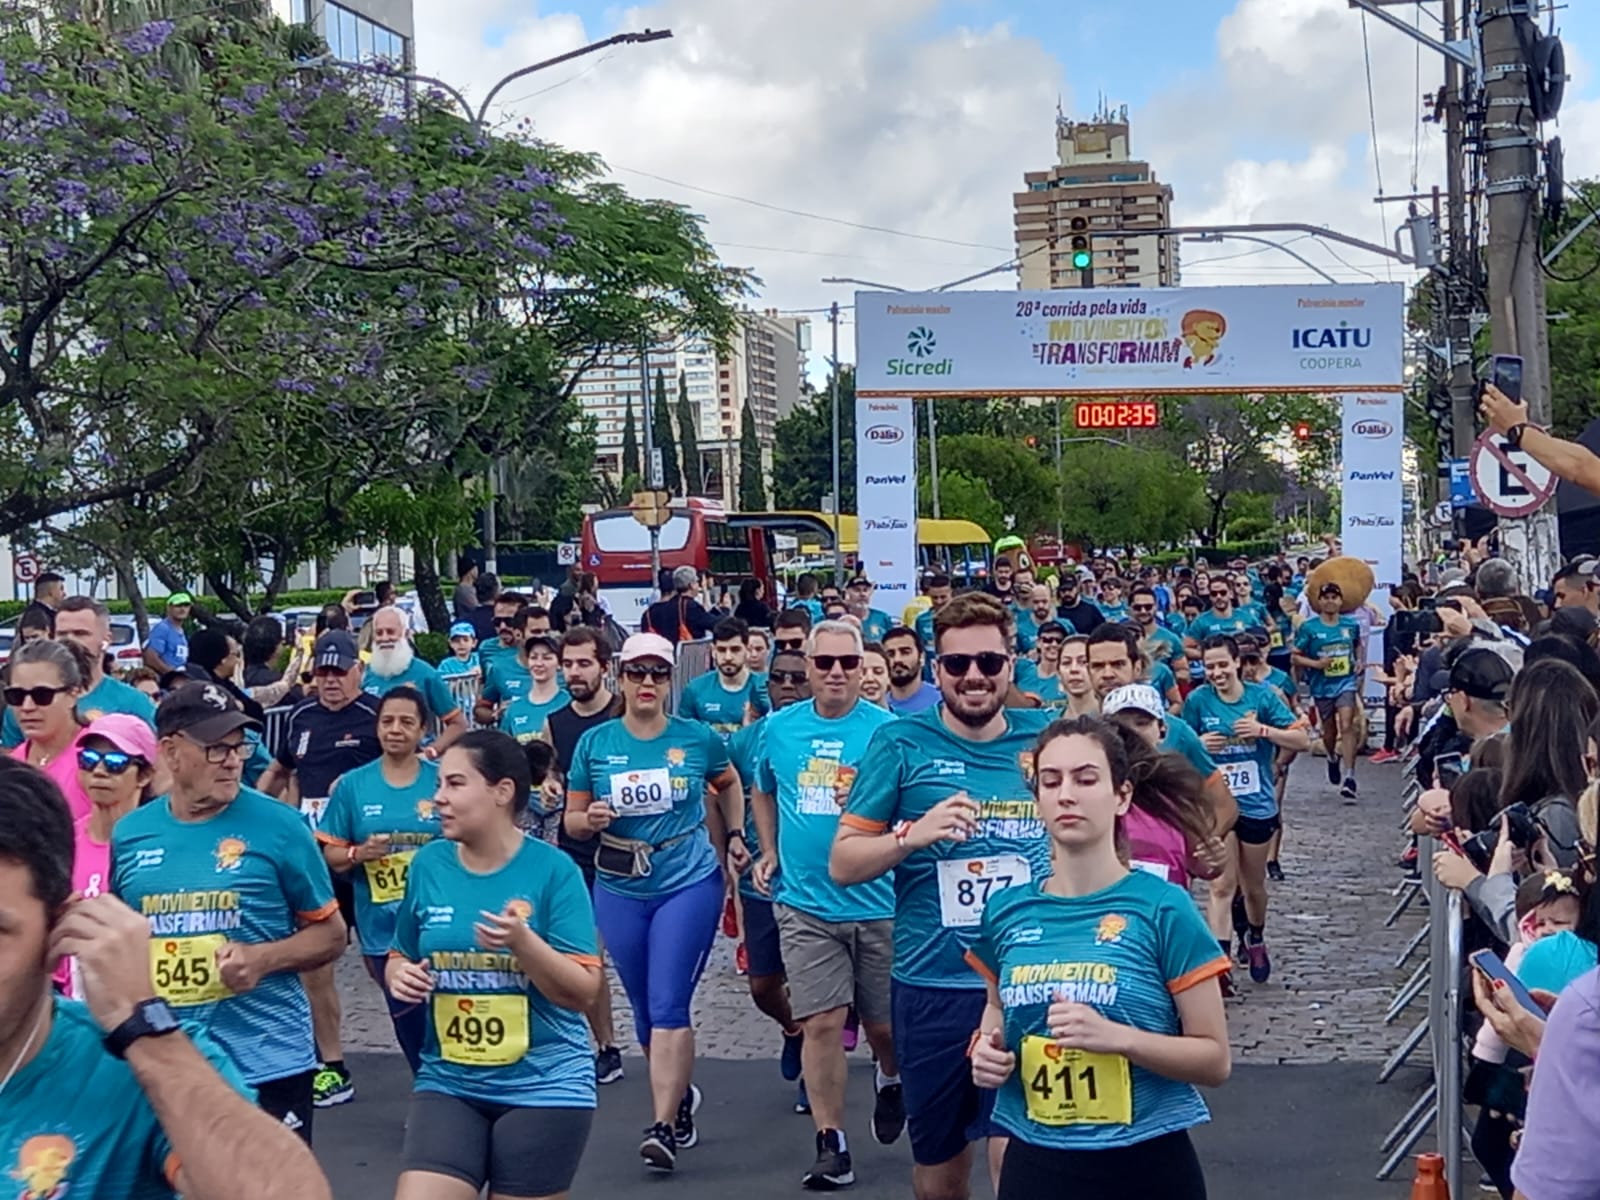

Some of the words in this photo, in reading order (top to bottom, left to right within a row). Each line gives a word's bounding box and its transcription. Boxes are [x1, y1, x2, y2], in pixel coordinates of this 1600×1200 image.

[1016, 301, 1040, 317] 28ª
[1042, 300, 1086, 316] corrida
[1089, 299, 1118, 318] pela
[1120, 298, 1147, 314] vida
[1049, 318, 1168, 341] MOVIMENTOS
[1292, 327, 1371, 349] ICATU
[1038, 341, 1181, 365] TRANSFORMAM
[1300, 357, 1362, 369] COOPERA
[886, 358, 953, 376] Sicredi
[1078, 405, 1156, 426] 00:02:35
[865, 475, 906, 484] PanVel
[1350, 471, 1394, 480] PanVel
[621, 782, 662, 805] 860
[957, 875, 1013, 907] 877
[156, 957, 210, 988] 545
[446, 1015, 505, 1046] 499
[1031, 1064, 1097, 1100] 411
